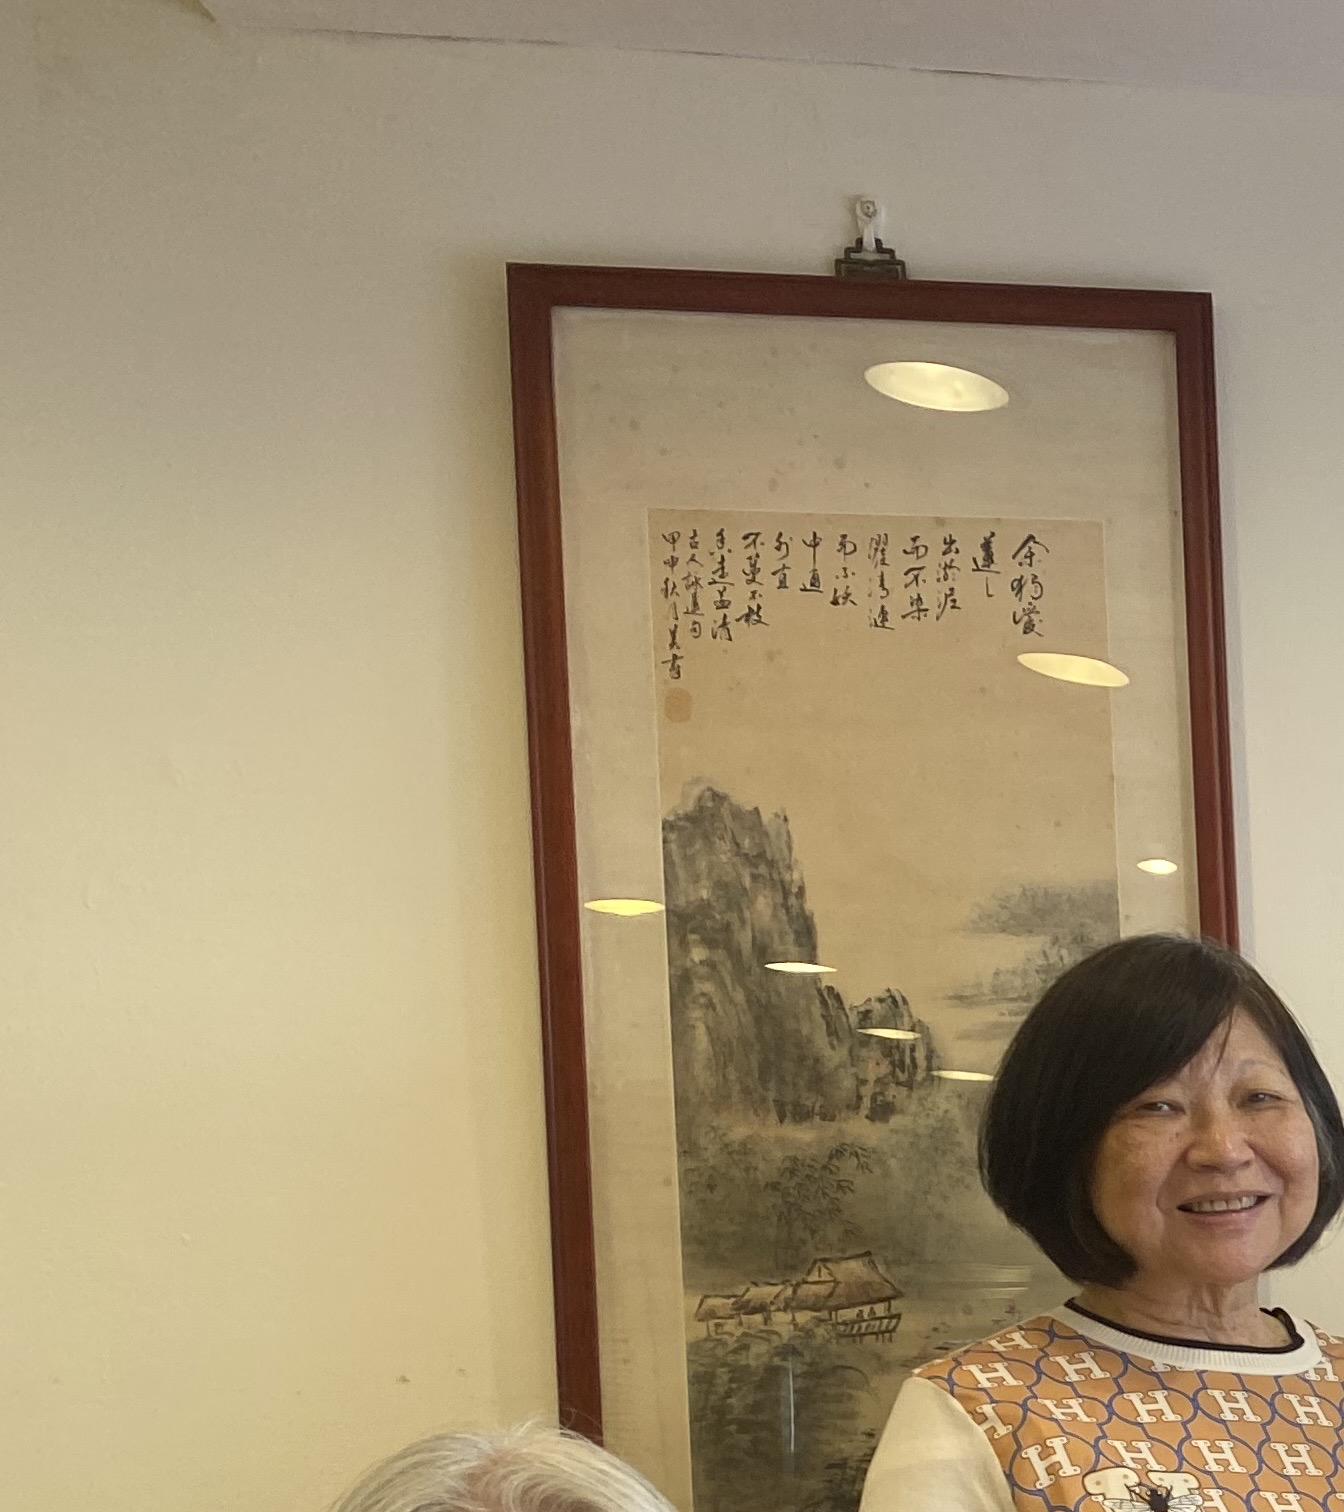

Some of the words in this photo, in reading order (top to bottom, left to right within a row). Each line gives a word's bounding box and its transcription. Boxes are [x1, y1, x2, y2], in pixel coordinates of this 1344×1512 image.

[964, 1360, 1023, 1388] H
[987, 1330, 1038, 1355] H
[1051, 1352, 1110, 1383] H
[1042, 1398, 1096, 1422] H
[1124, 1390, 1181, 1424] H
[1206, 1389, 1262, 1423] H
[1284, 1392, 1335, 1428] H
[1022, 1435, 1081, 1490] H
[1106, 1439, 1165, 1473] H
[1191, 1439, 1248, 1474] H
[1270, 1442, 1322, 1477] H
